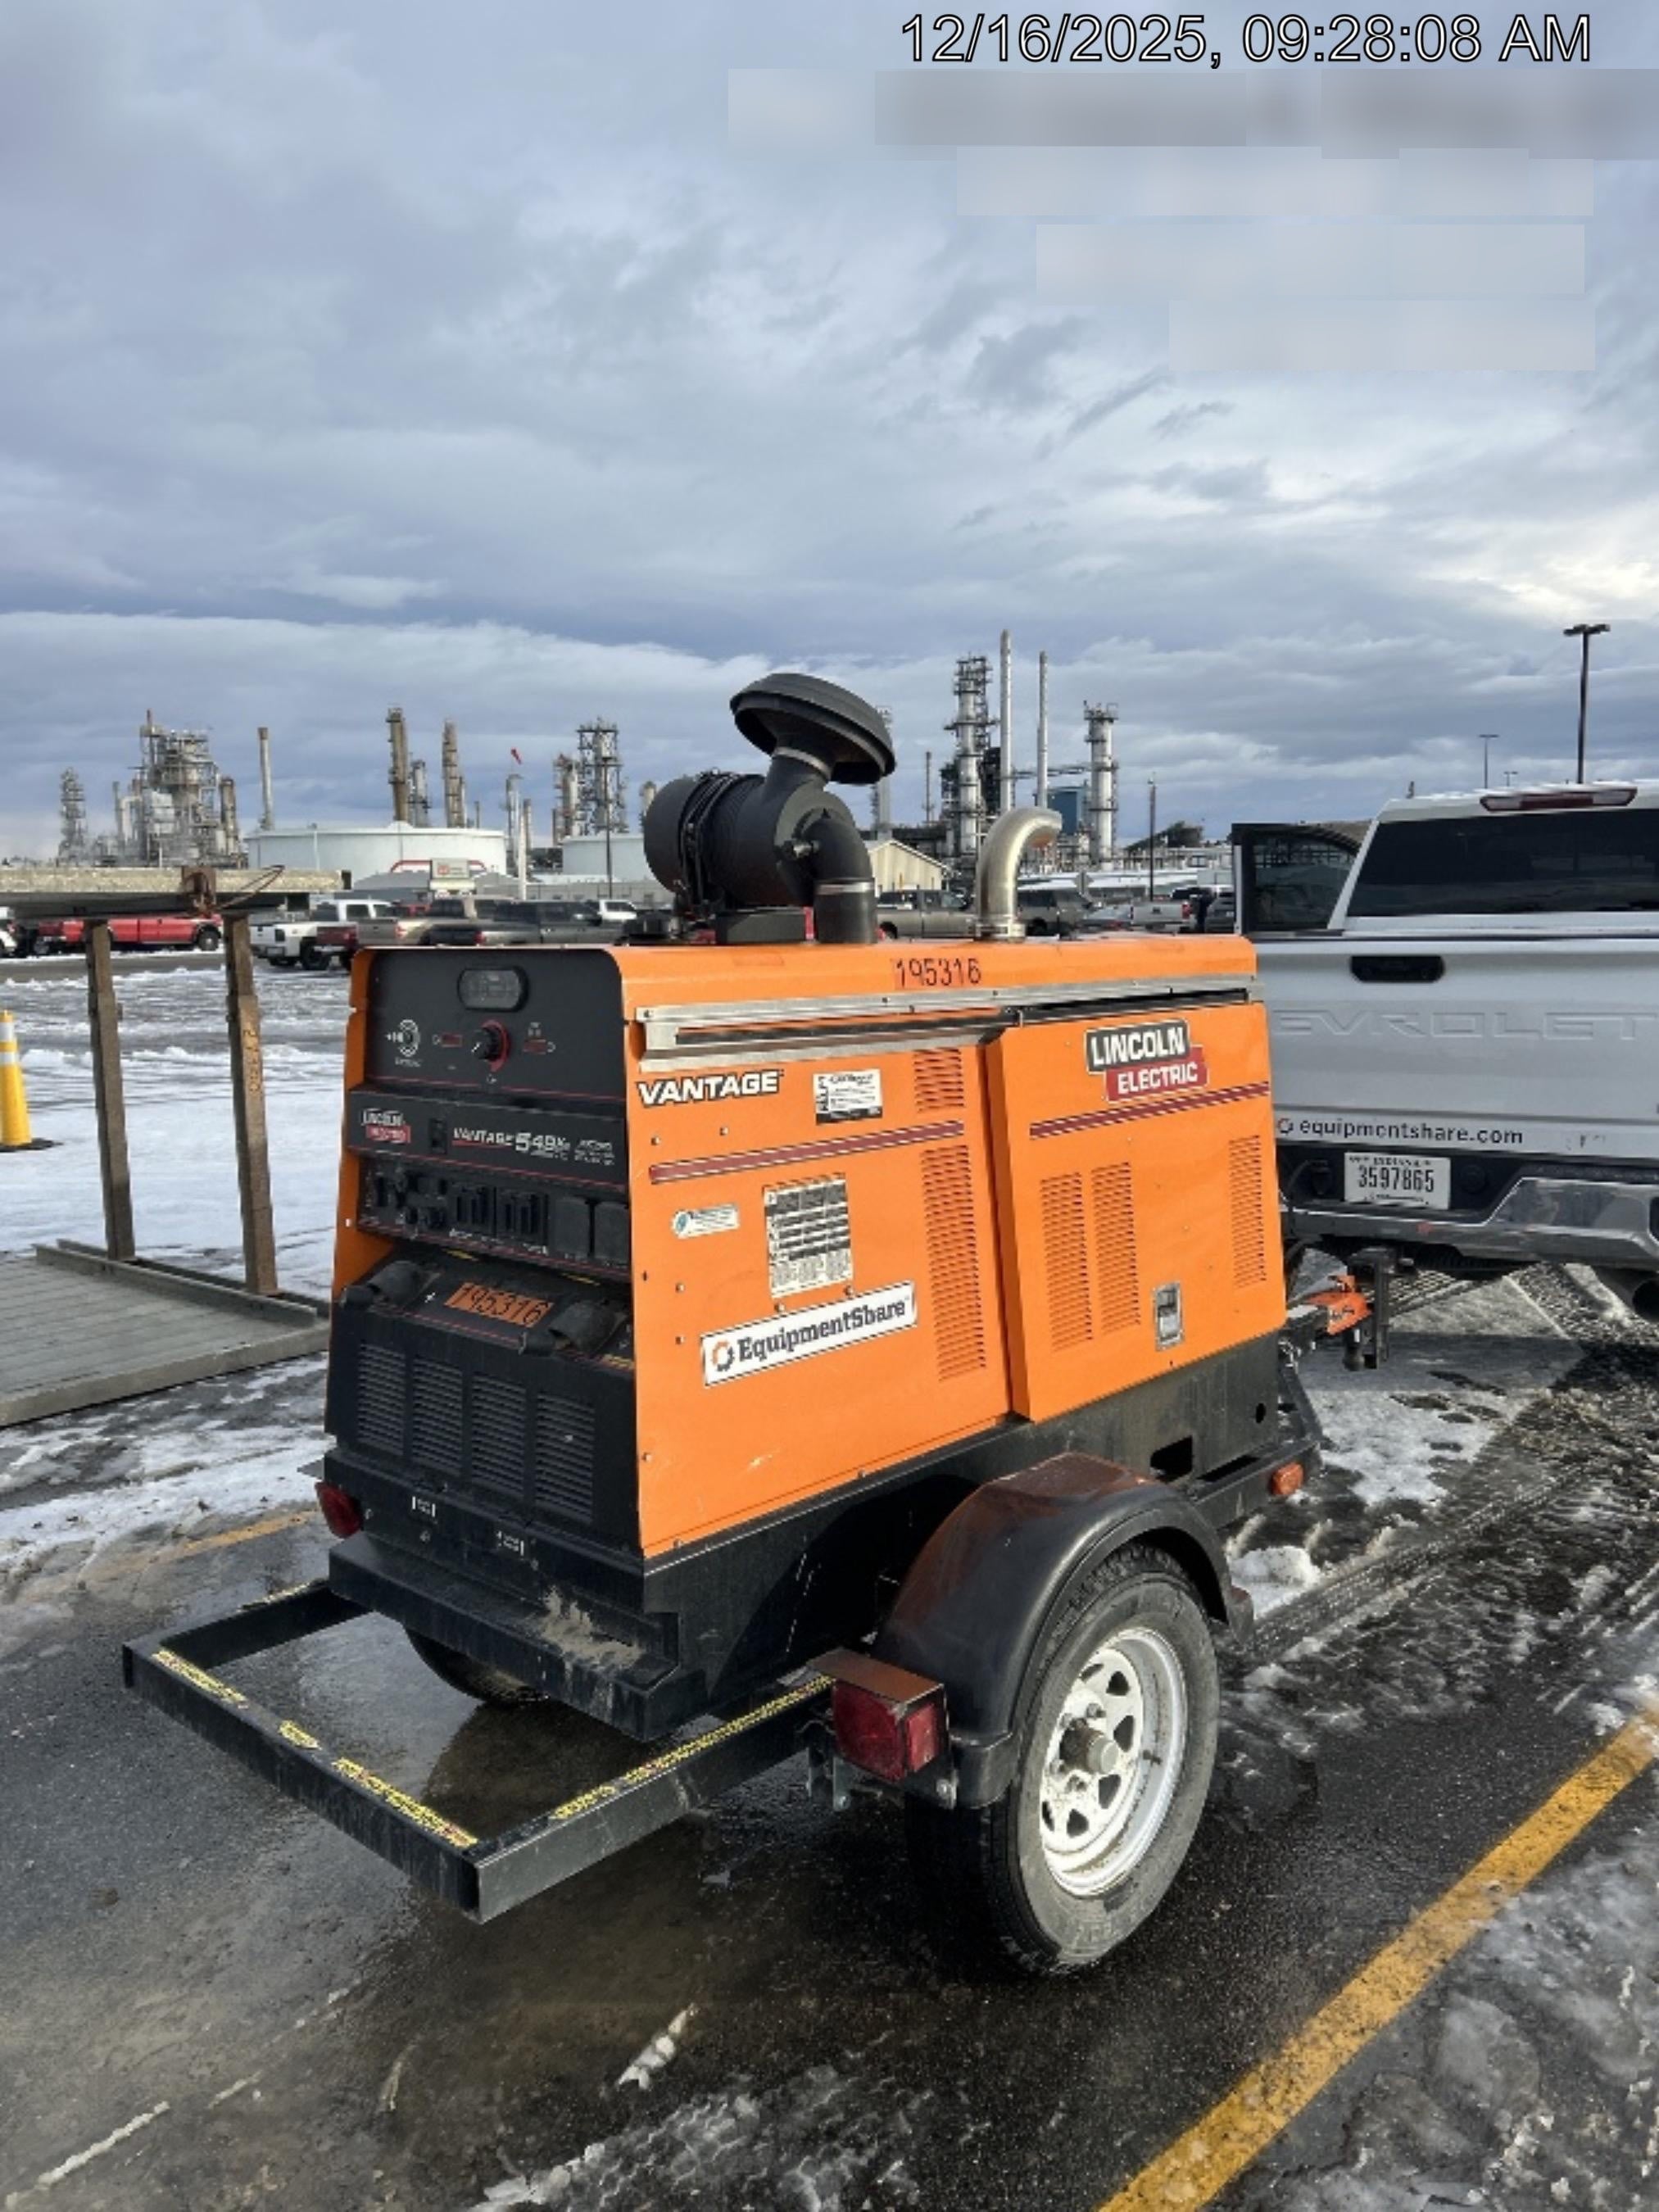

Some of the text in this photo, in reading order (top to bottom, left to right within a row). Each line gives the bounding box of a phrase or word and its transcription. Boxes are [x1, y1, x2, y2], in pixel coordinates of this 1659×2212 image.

[895, 957, 981, 989] 195316
[1090, 1027, 1186, 1067] LINCOLN
[636, 1069, 781, 1107] VANTAGE
[1117, 1061, 1199, 1095] ELECTRIC
[1299, 1119, 1523, 1145] equipmentshare.com
[1358, 1164, 1435, 1193] 3597865
[737, 1300, 906, 1362] EquipmentShare
